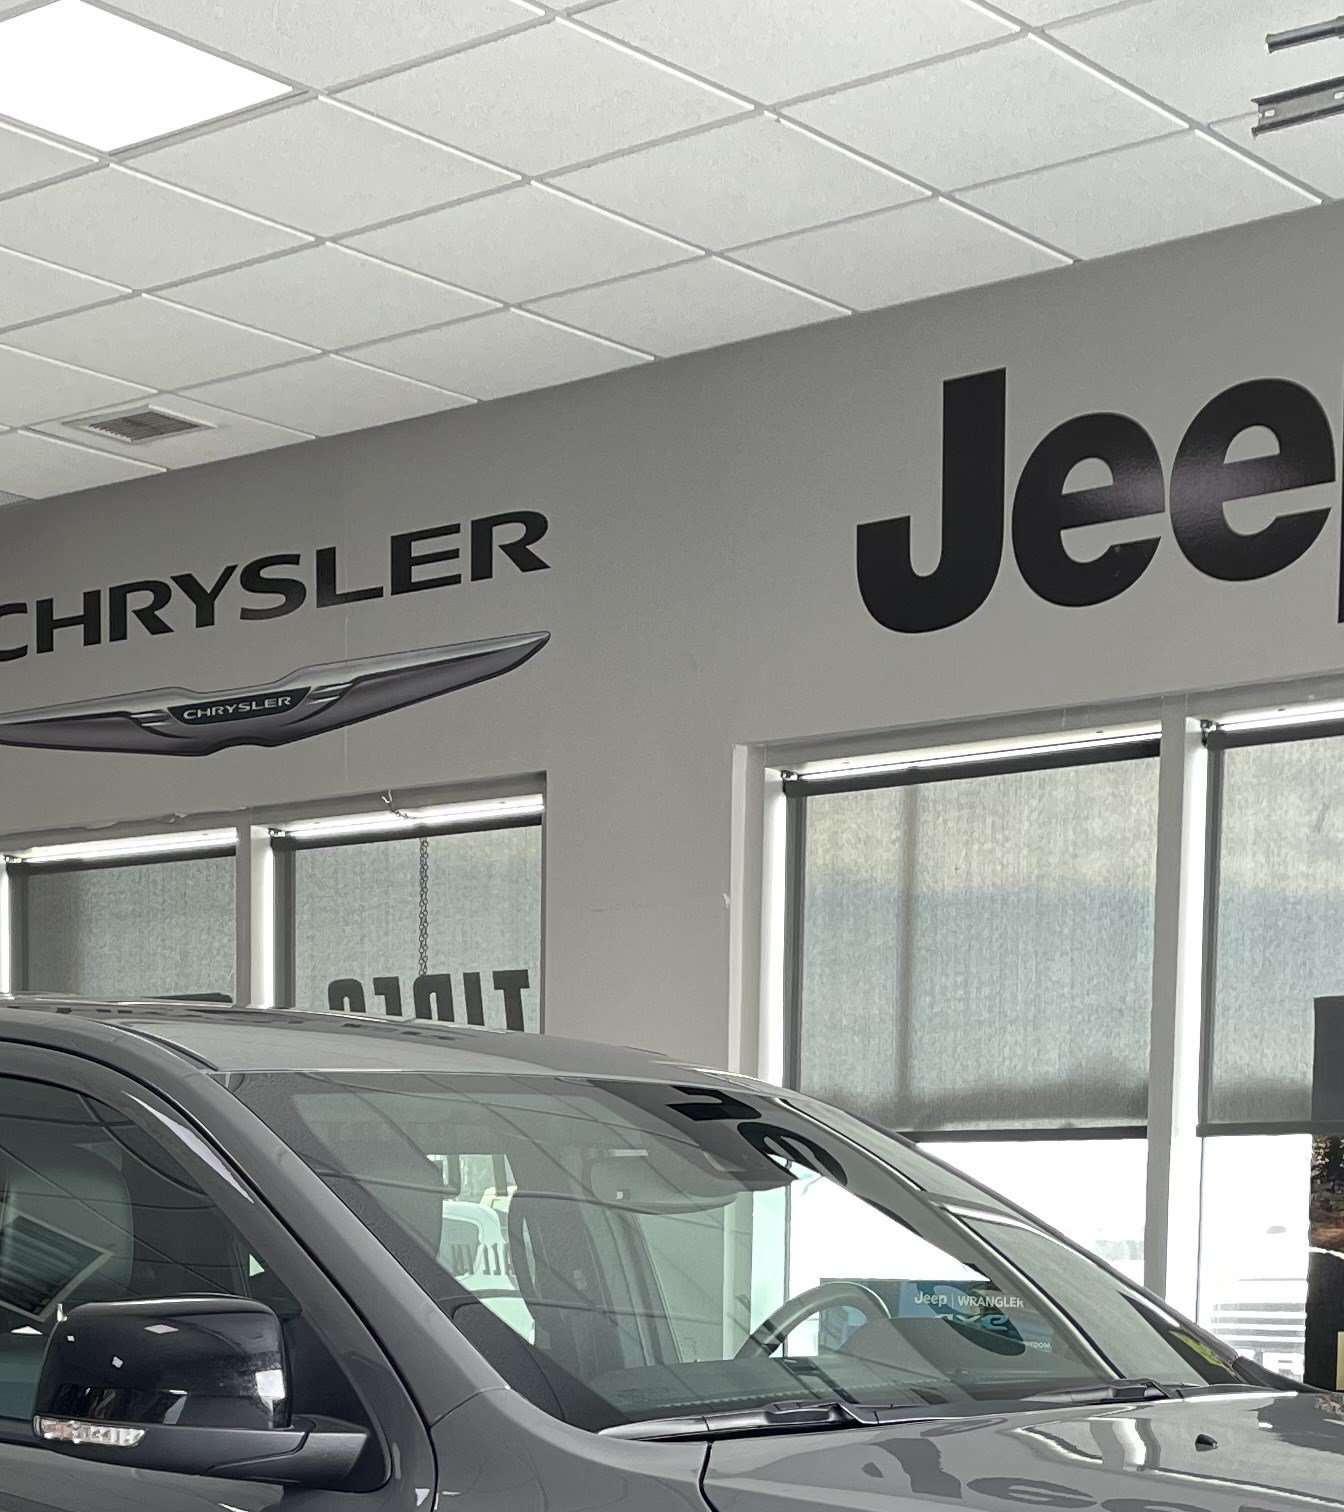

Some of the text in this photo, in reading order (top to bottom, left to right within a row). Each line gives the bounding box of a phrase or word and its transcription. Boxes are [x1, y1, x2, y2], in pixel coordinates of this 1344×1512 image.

[183, 694, 293, 720] CHRYSLER
[914, 1290, 1025, 1309] Jeep WRANGLER
